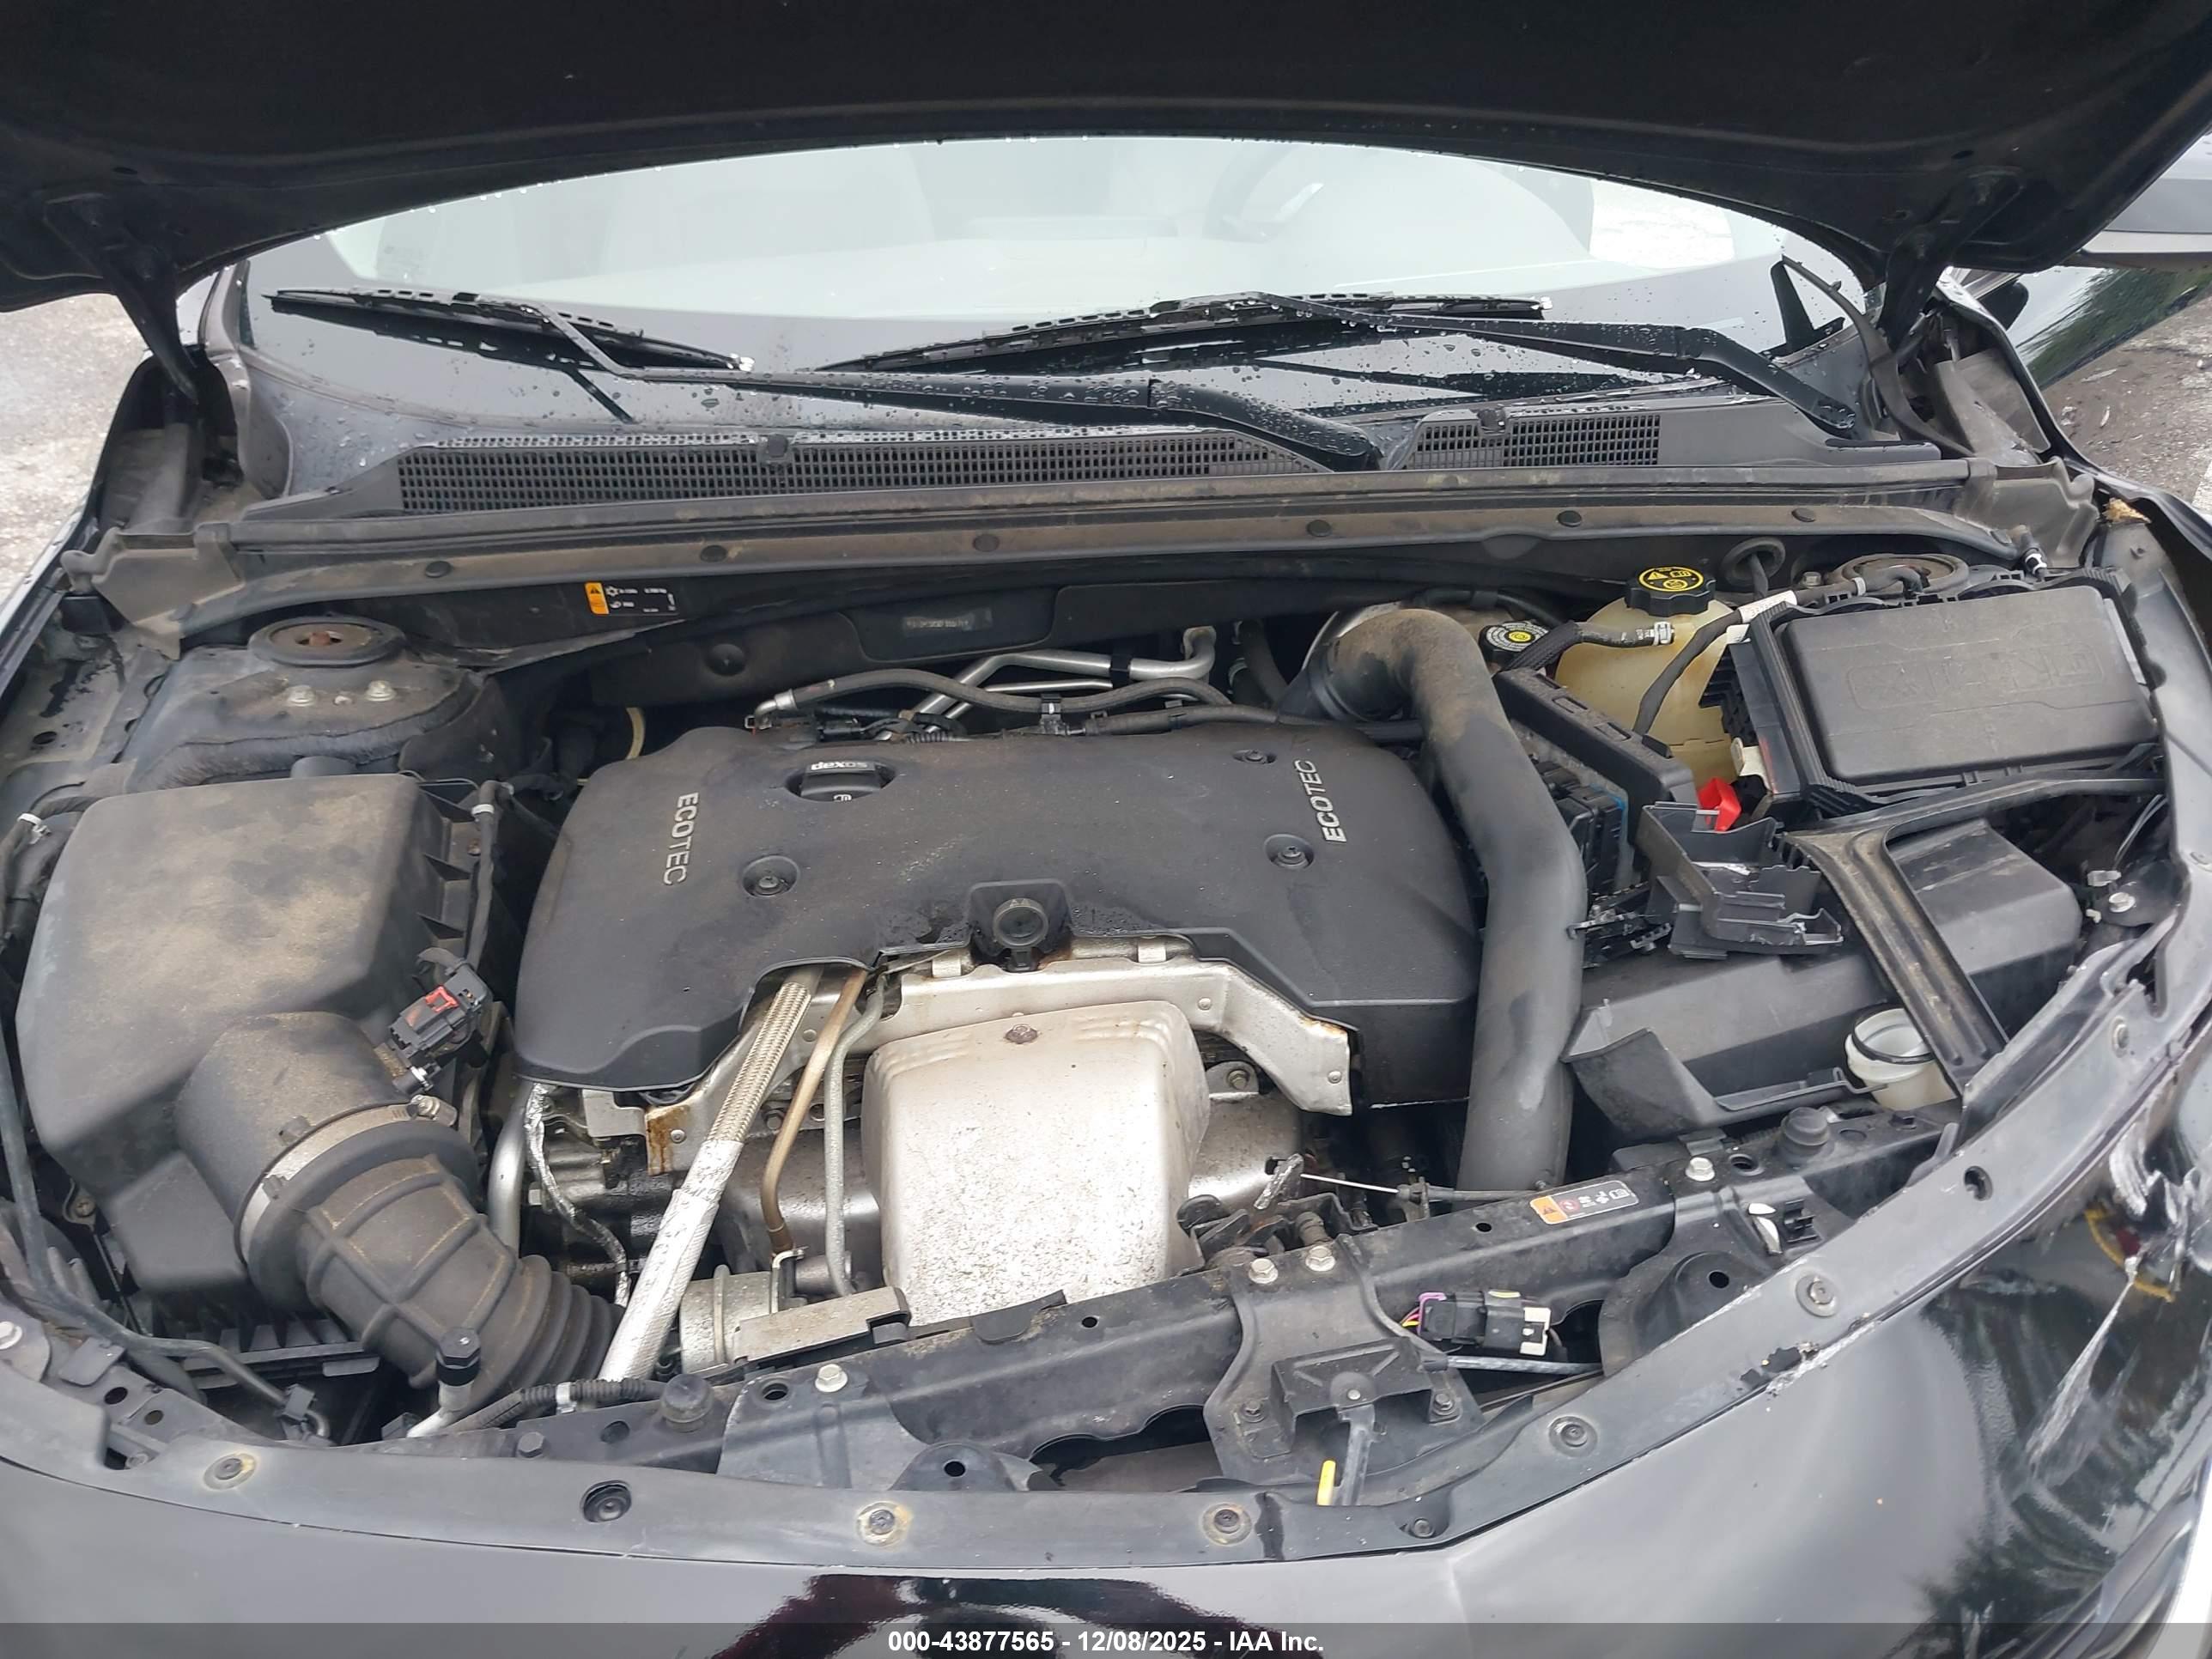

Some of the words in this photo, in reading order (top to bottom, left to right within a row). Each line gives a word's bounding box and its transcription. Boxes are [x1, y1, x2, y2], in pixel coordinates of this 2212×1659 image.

[811, 761, 867, 771] dexos
[1294, 759, 1347, 843] ECOTEC
[663, 792, 699, 885] ECOTEC
